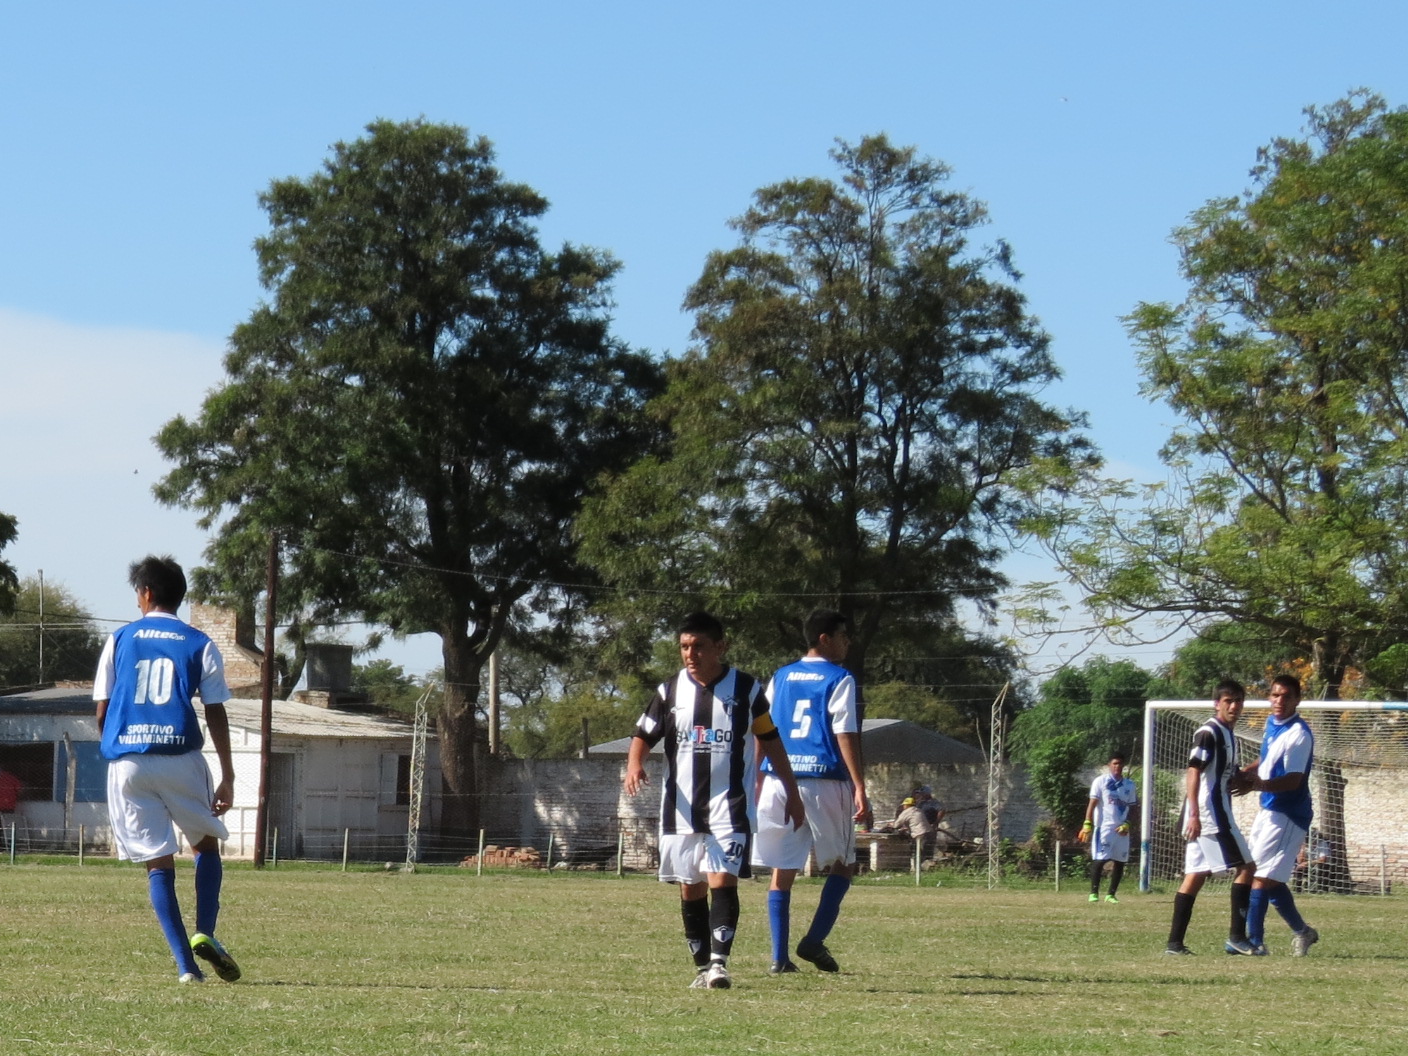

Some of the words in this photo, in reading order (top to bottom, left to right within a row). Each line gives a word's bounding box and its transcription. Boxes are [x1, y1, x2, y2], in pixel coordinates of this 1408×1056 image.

[134, 658, 174, 705] 10
[126, 723, 174, 735] SPORTIVO
[790, 700, 812, 738] 5
[725, 841, 744, 859] 10
